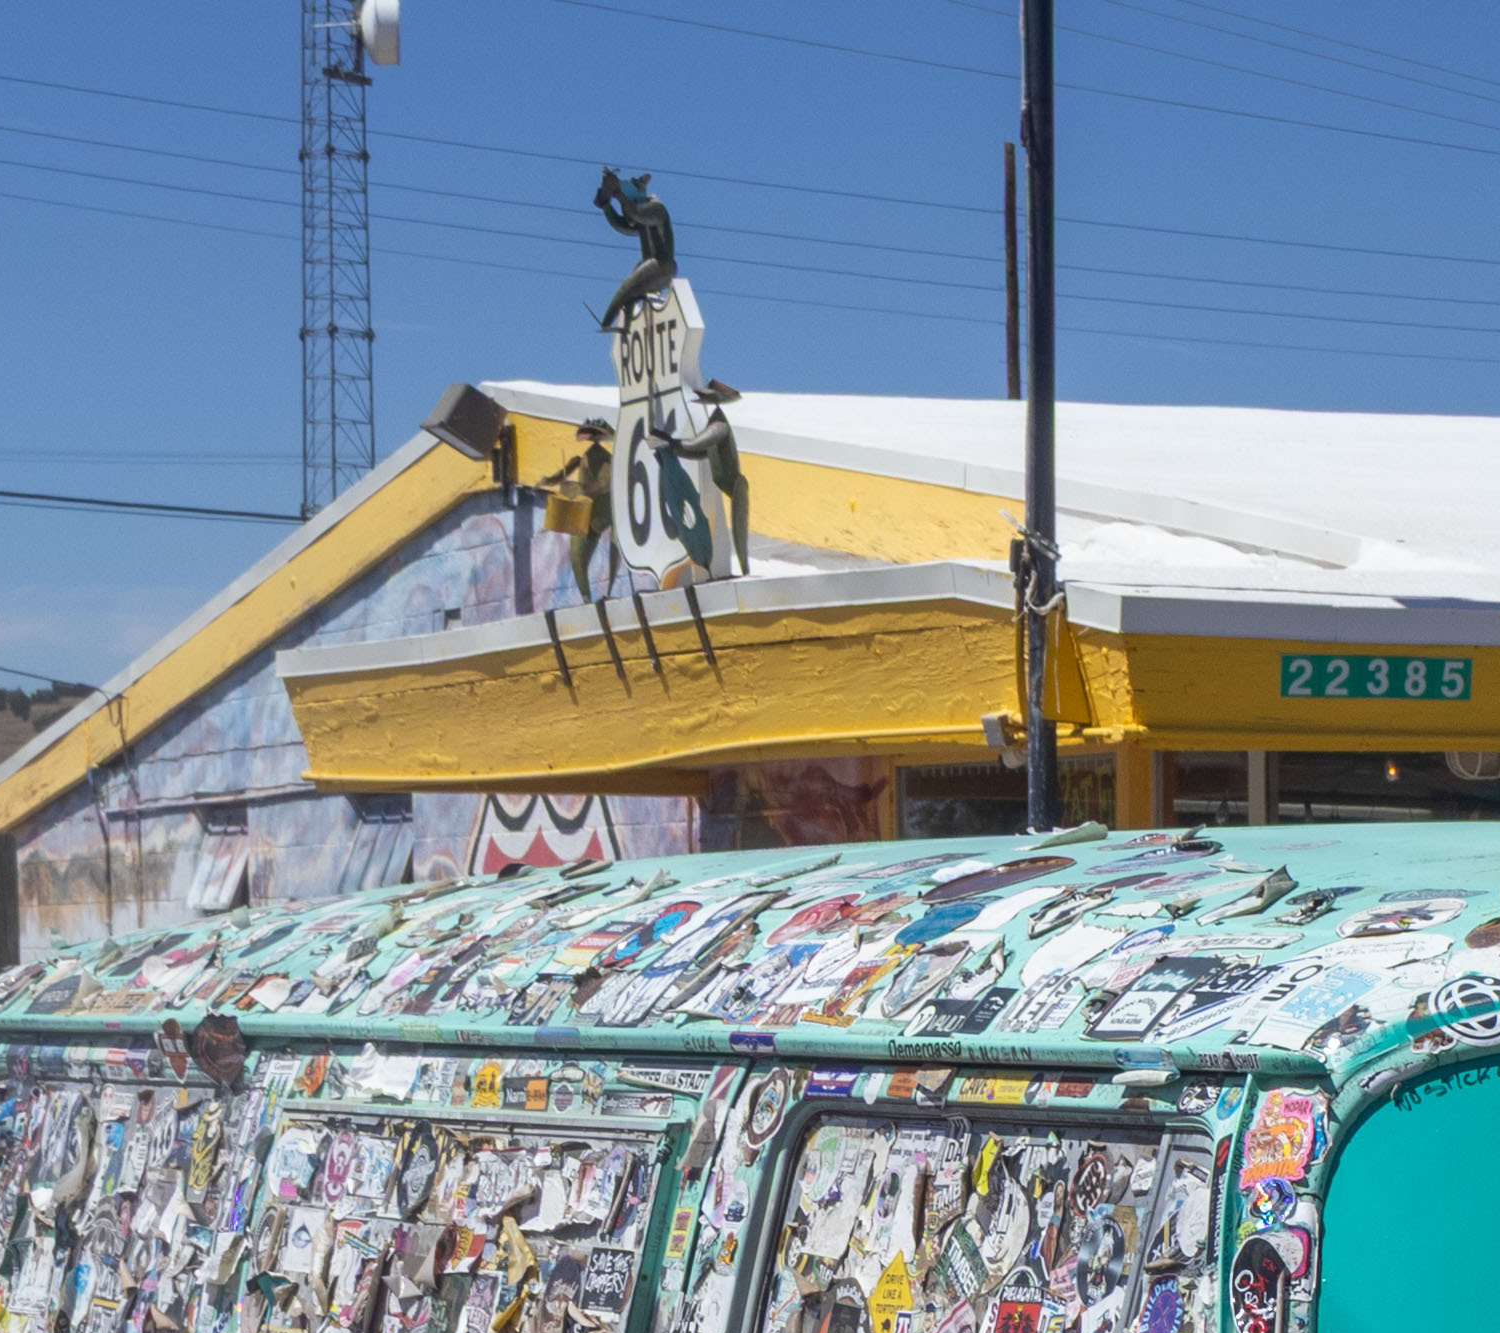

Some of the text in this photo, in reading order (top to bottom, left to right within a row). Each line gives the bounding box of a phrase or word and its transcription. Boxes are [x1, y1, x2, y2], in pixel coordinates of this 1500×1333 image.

[620, 319, 679, 387] ROUTE
[1287, 658, 1465, 697] 22385
[1235, 1053, 1260, 1070] SHOT
